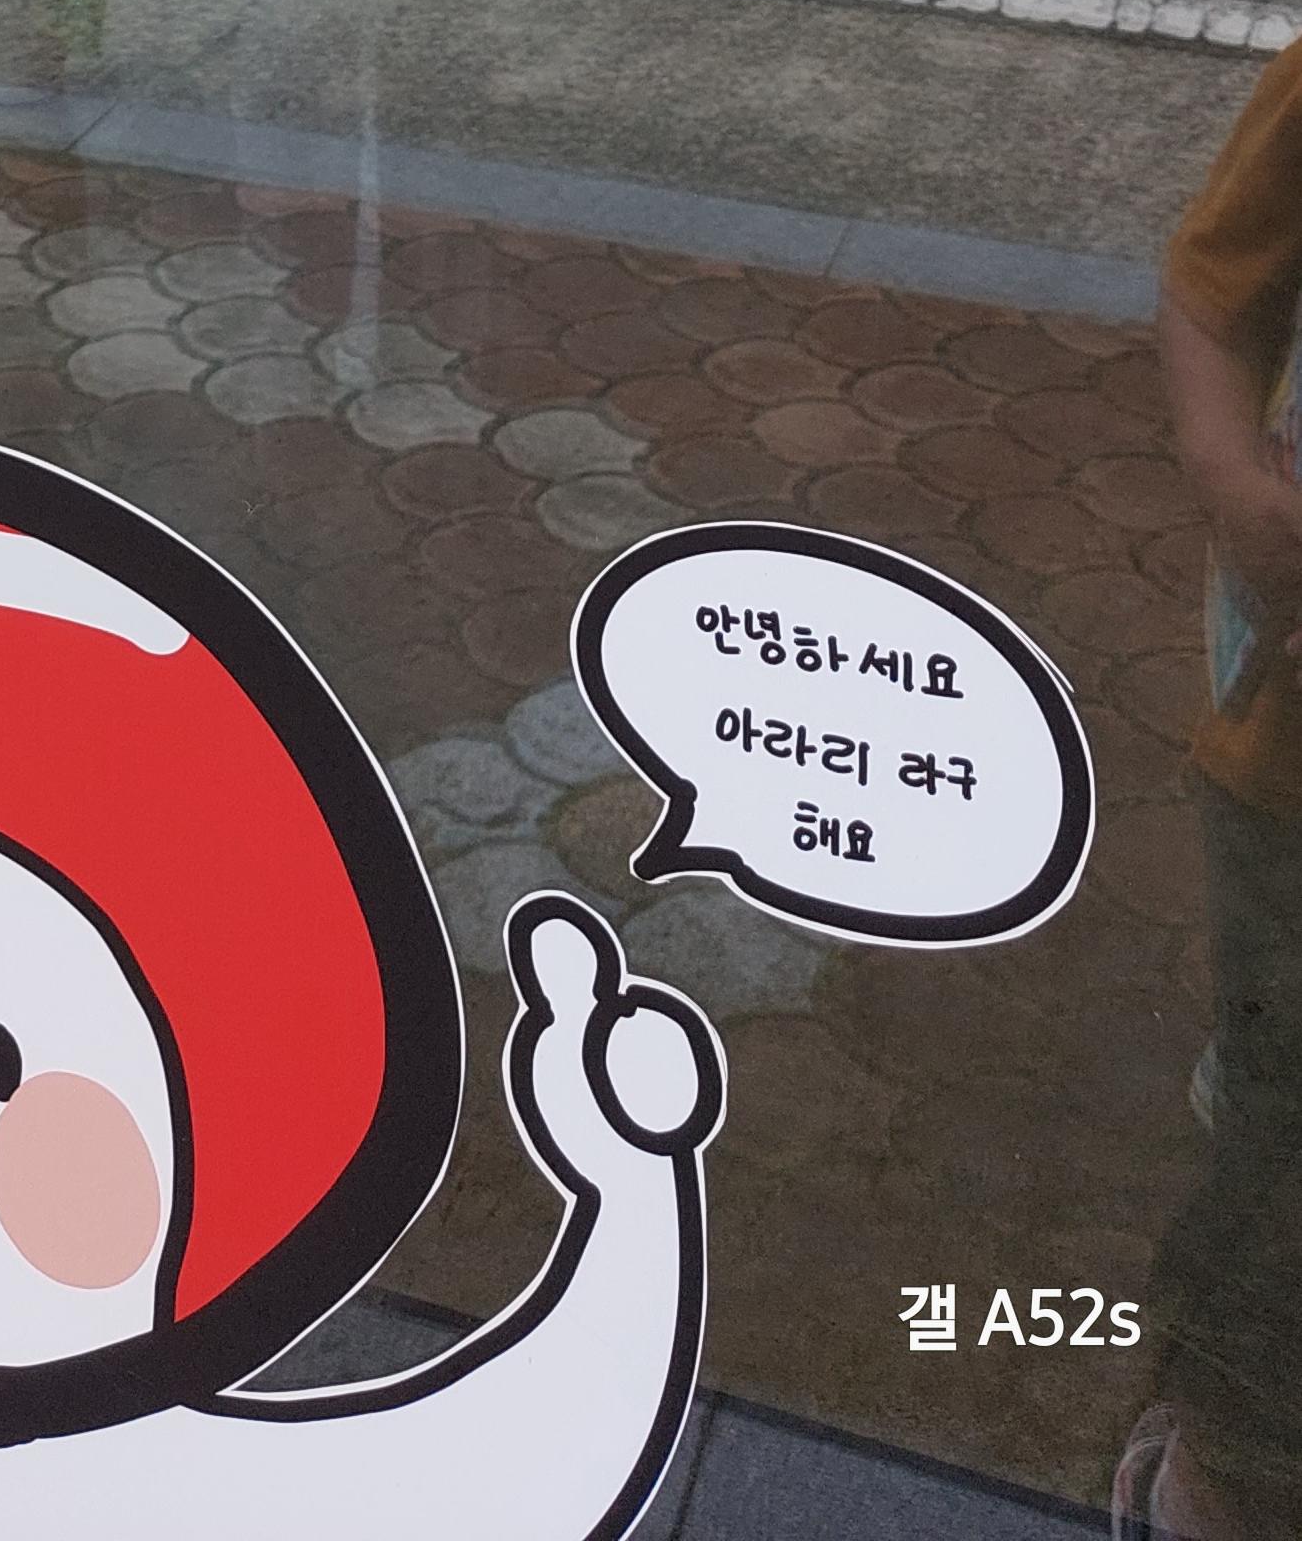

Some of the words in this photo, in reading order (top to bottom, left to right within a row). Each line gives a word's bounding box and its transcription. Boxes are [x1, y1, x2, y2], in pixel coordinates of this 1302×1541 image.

[695, 604, 965, 699] 안녕하세요
[715, 707, 871, 787] 아라리
[898, 752, 978, 801] 라구
[793, 800, 876, 863] 해요
